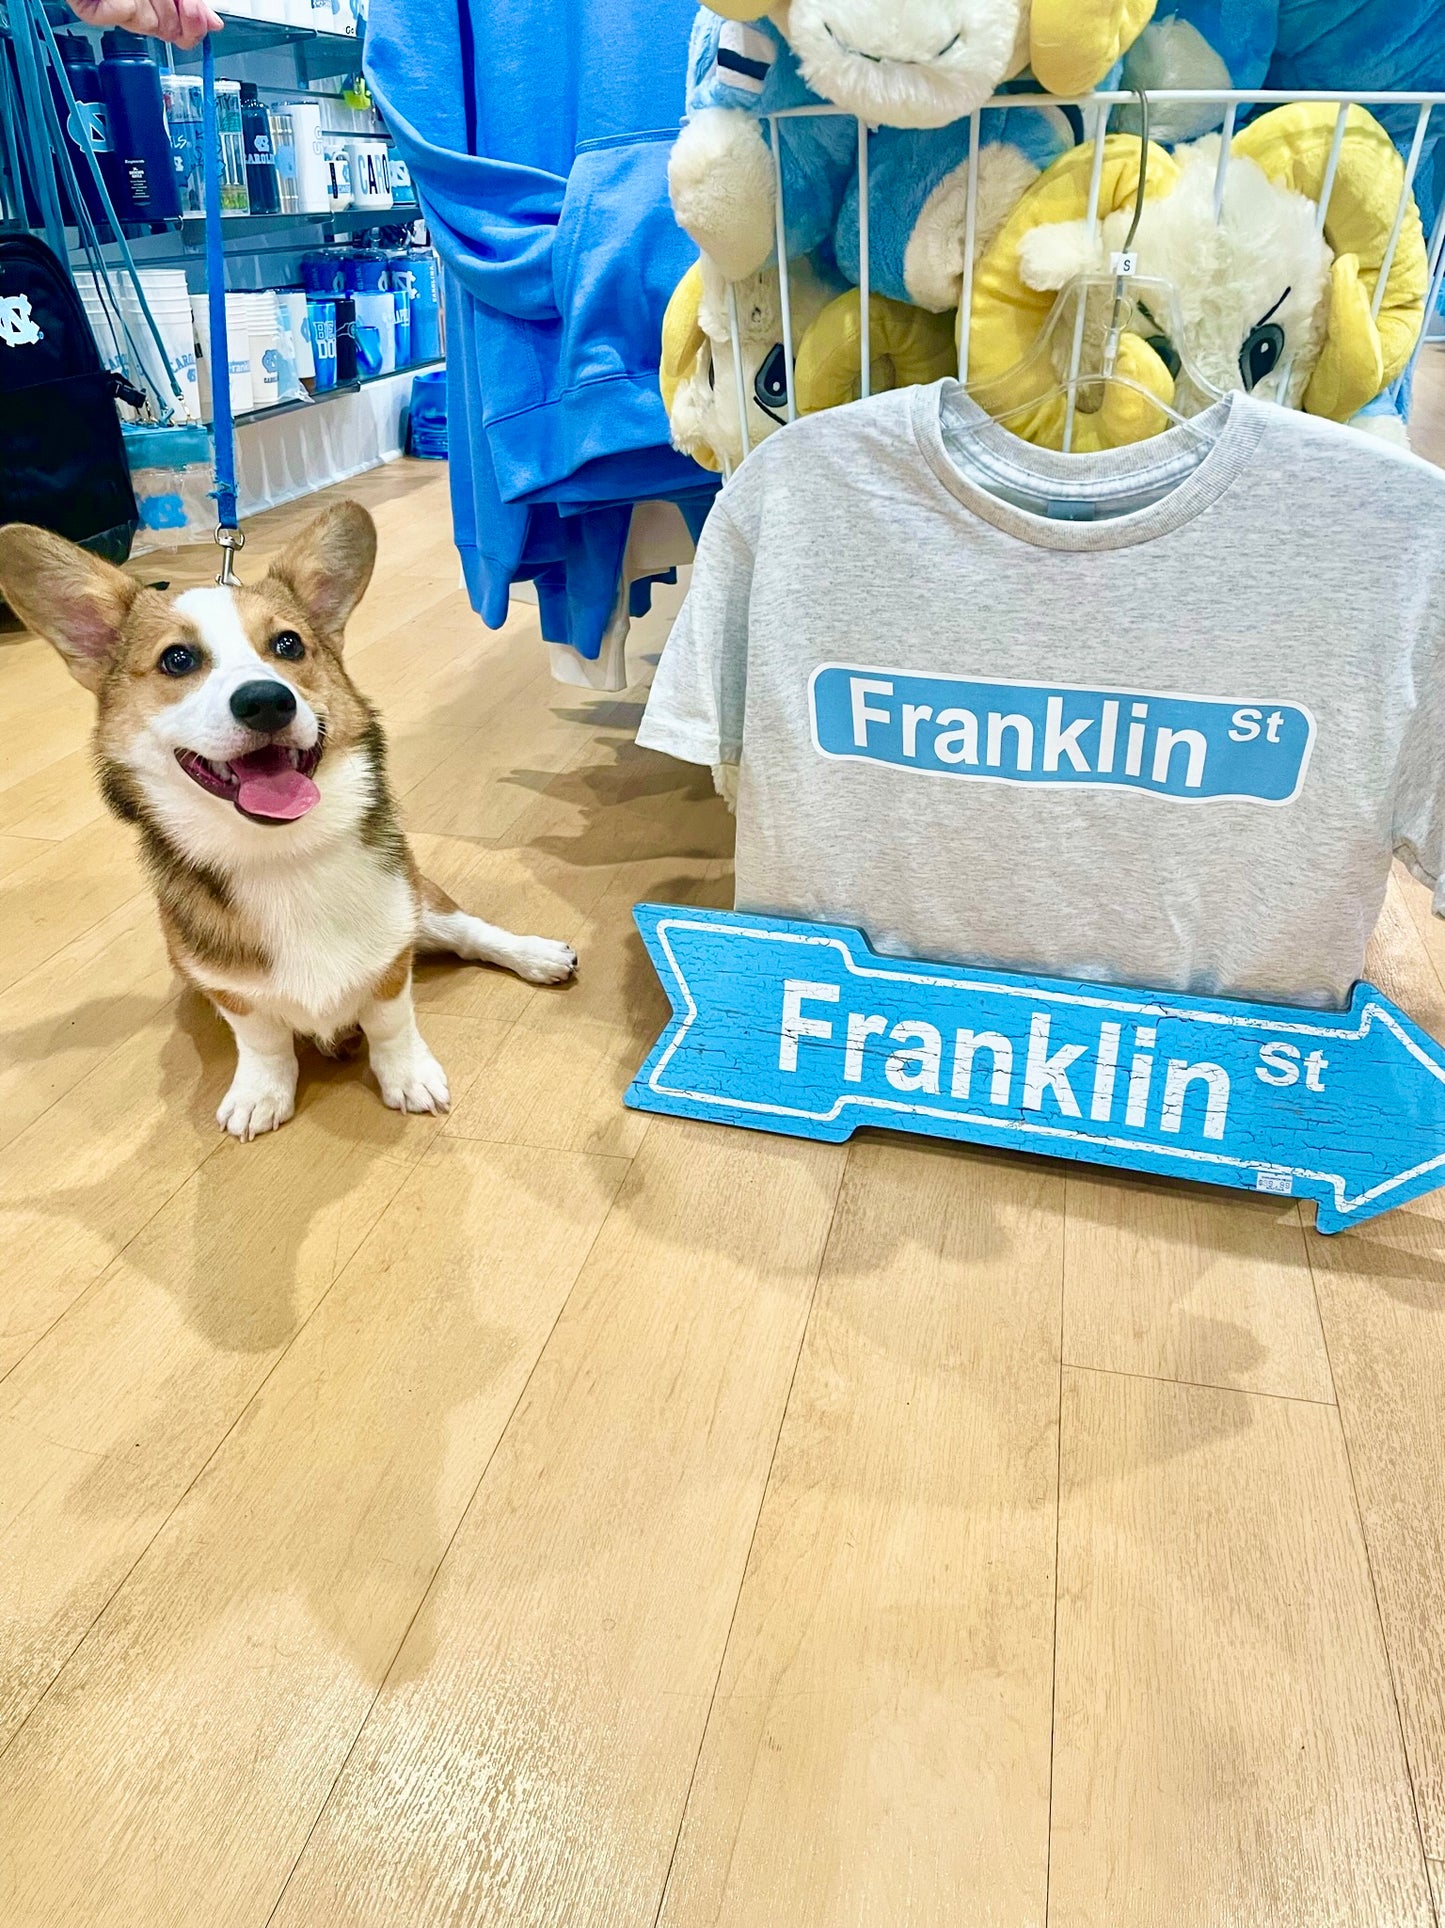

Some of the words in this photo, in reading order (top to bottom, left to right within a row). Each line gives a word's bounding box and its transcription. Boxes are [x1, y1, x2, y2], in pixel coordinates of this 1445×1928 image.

[1123, 259, 1131, 271] S
[850, 677, 1208, 788] Franklin
[1228, 707, 1284, 744] St
[777, 978, 1231, 1140] Franklin
[1254, 1040, 1328, 1092] St
